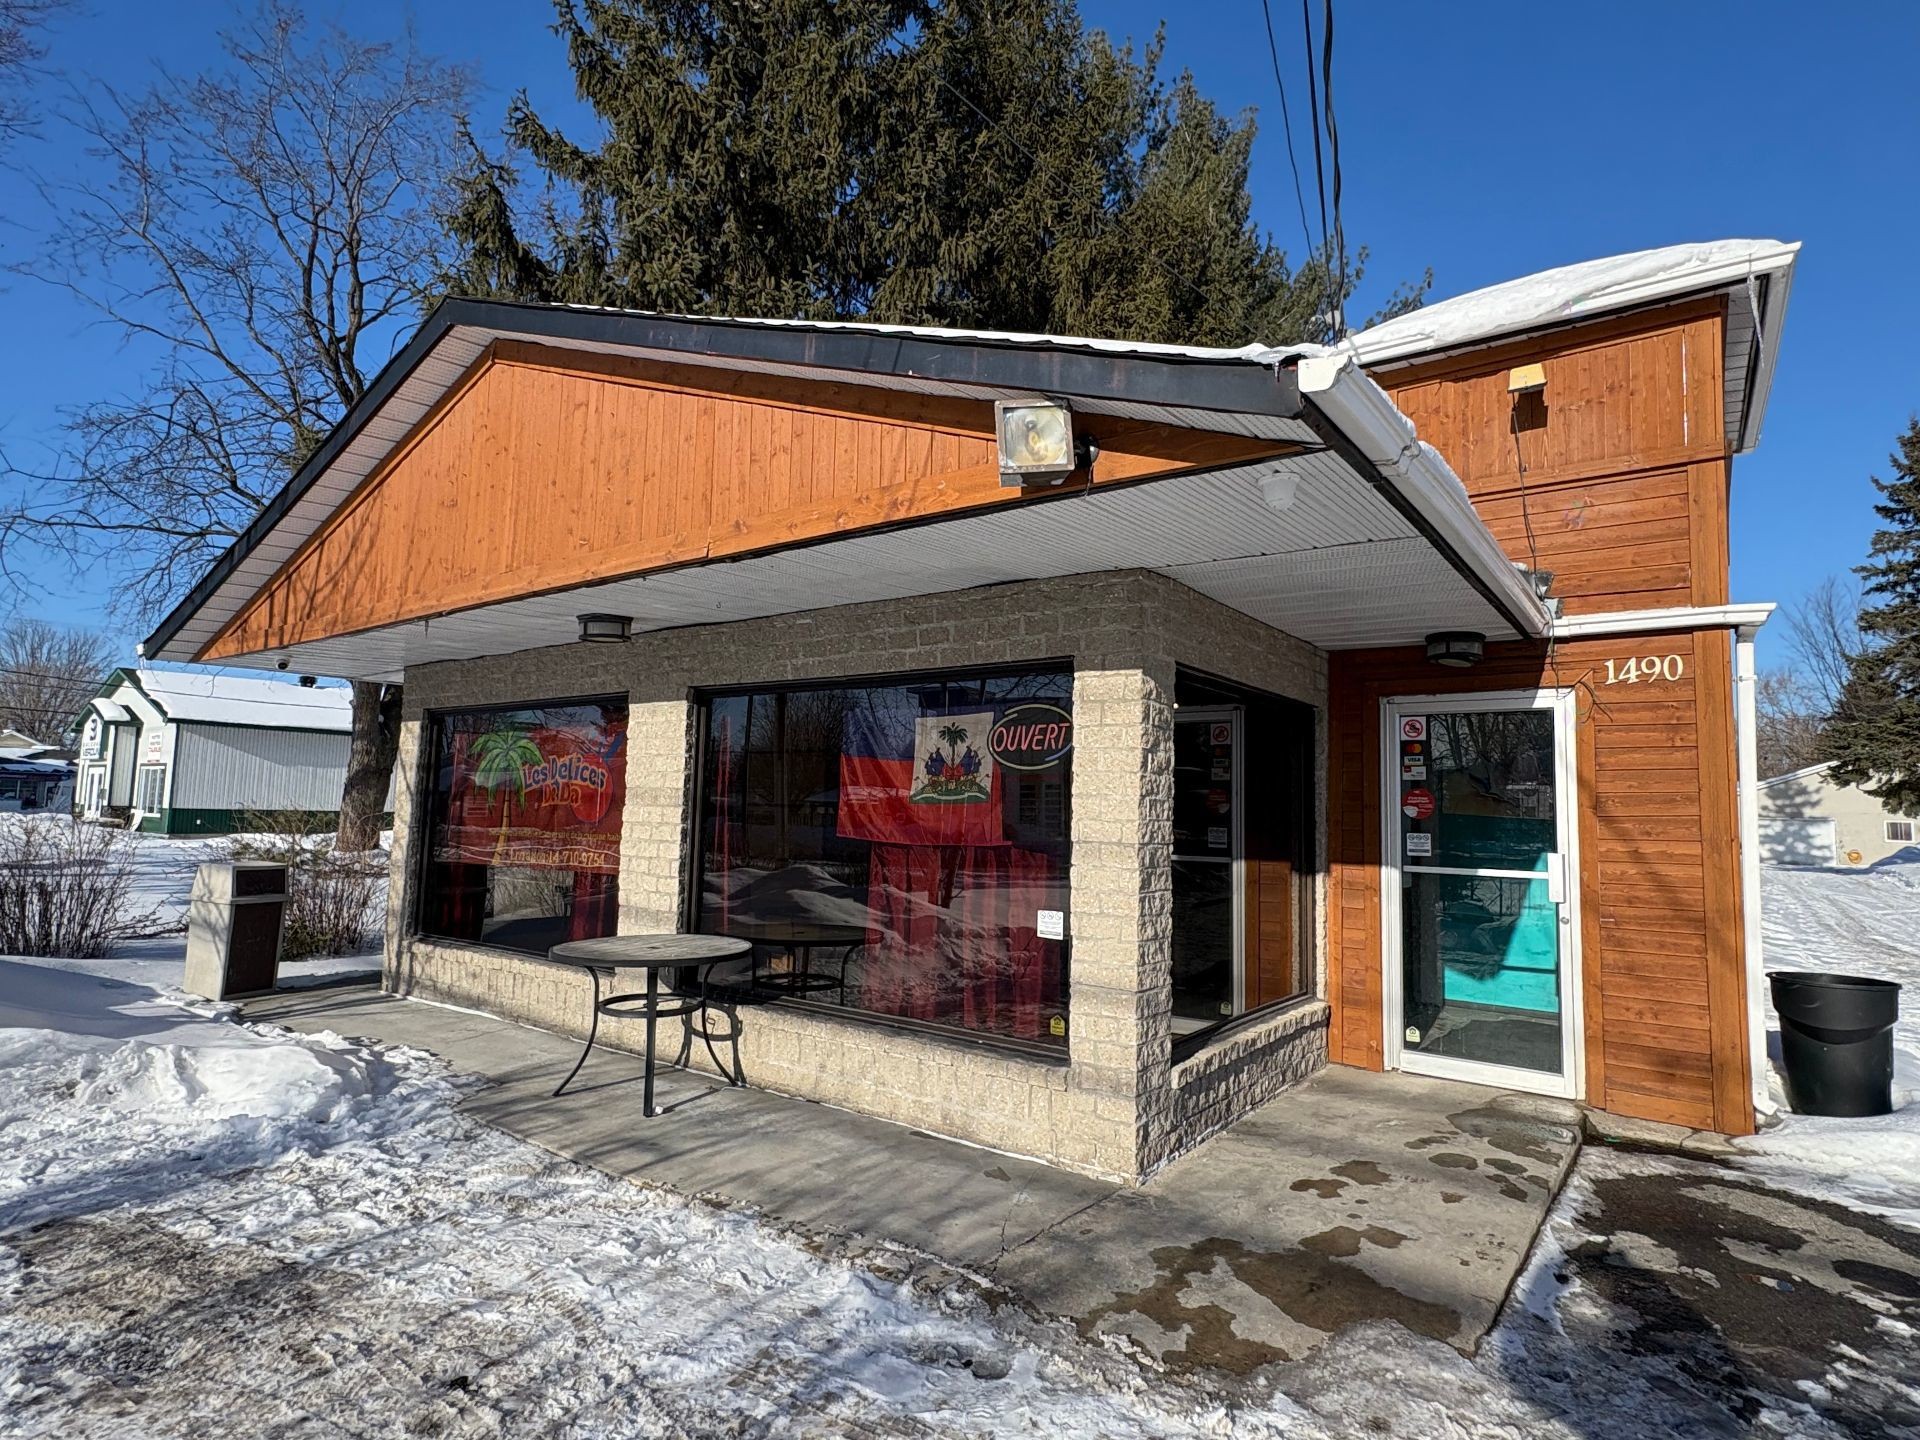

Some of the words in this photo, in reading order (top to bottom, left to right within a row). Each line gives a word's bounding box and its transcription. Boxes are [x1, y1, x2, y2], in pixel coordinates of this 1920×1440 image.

[1604, 654, 1684, 684] 1490
[993, 723, 1070, 752] OUVERT
[523, 763, 549, 791] Les
